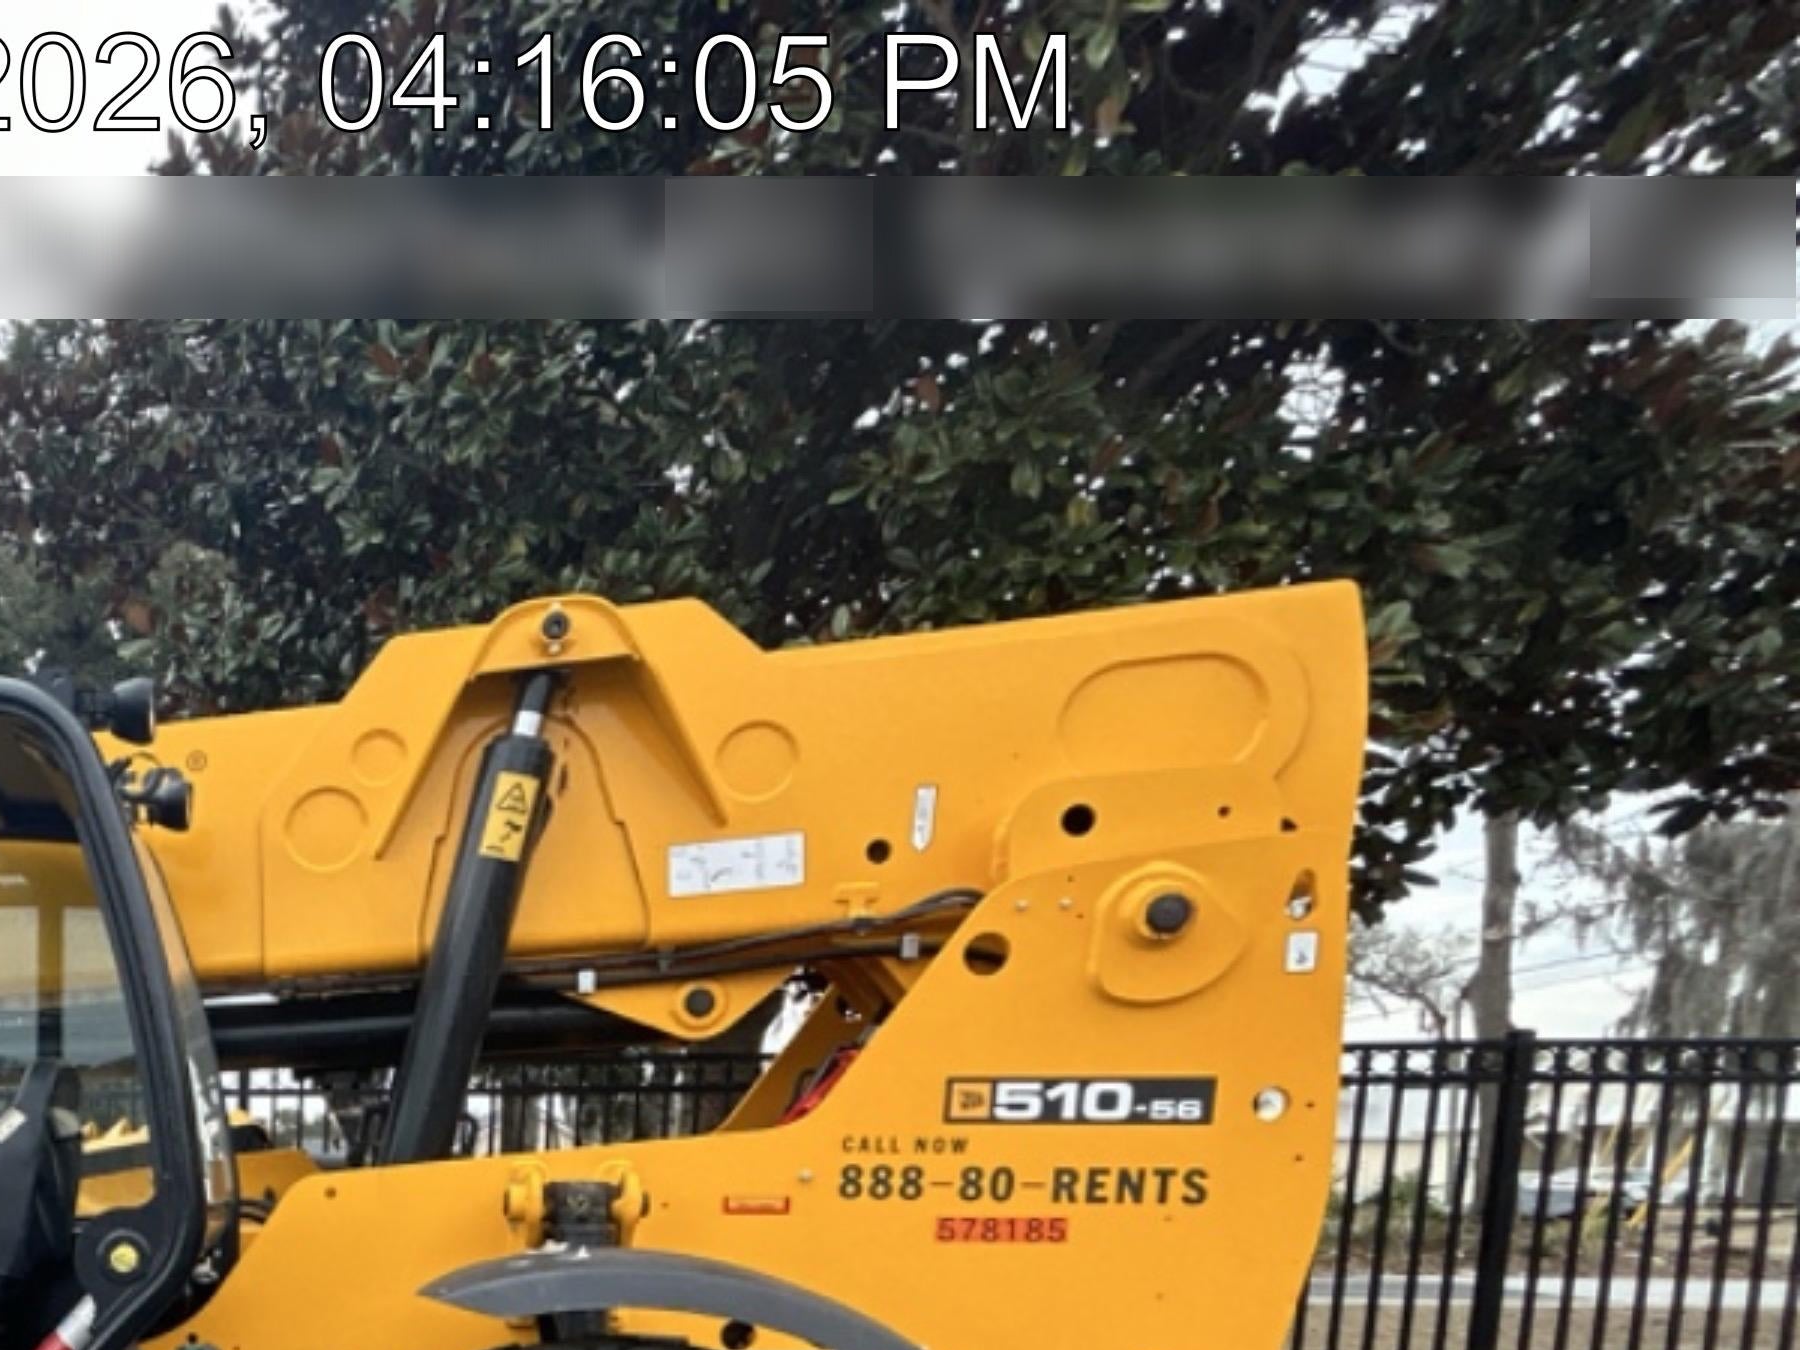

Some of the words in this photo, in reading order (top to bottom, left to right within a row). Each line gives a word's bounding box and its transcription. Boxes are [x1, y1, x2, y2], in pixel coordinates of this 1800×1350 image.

[993, 1080, 1203, 1122] 510-56
[841, 1135, 901, 1155] CALL
[914, 1135, 970, 1155] NOW
[936, 1217, 1068, 1243] 578185
